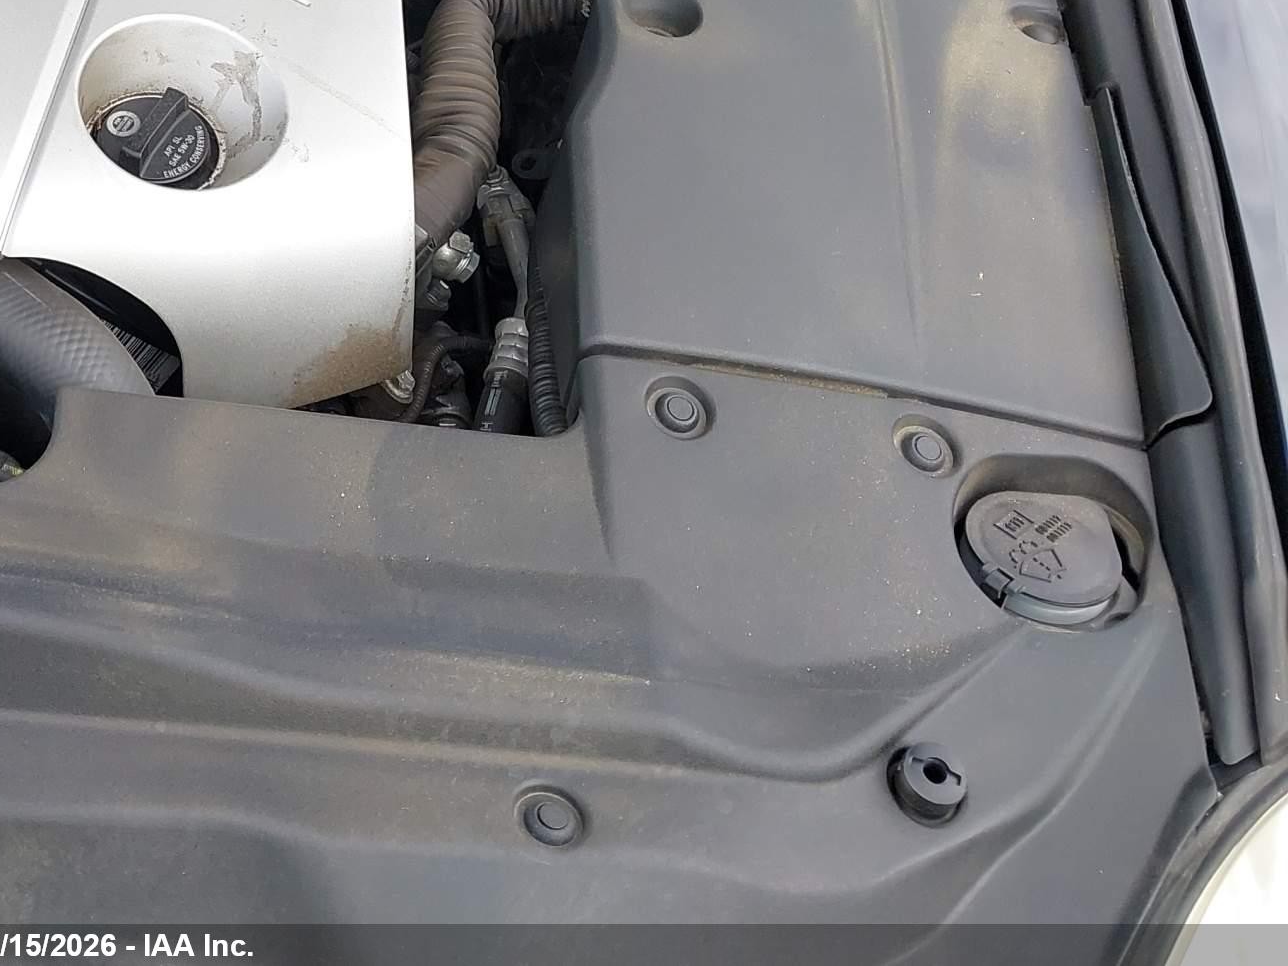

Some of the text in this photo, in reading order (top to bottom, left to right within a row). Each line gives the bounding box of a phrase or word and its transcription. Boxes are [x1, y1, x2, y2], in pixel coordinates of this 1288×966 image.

[163, 136, 183, 157] API SL
[163, 125, 205, 179] ENERGY CONSERVING
[168, 134, 195, 167] SAE 5W-30
